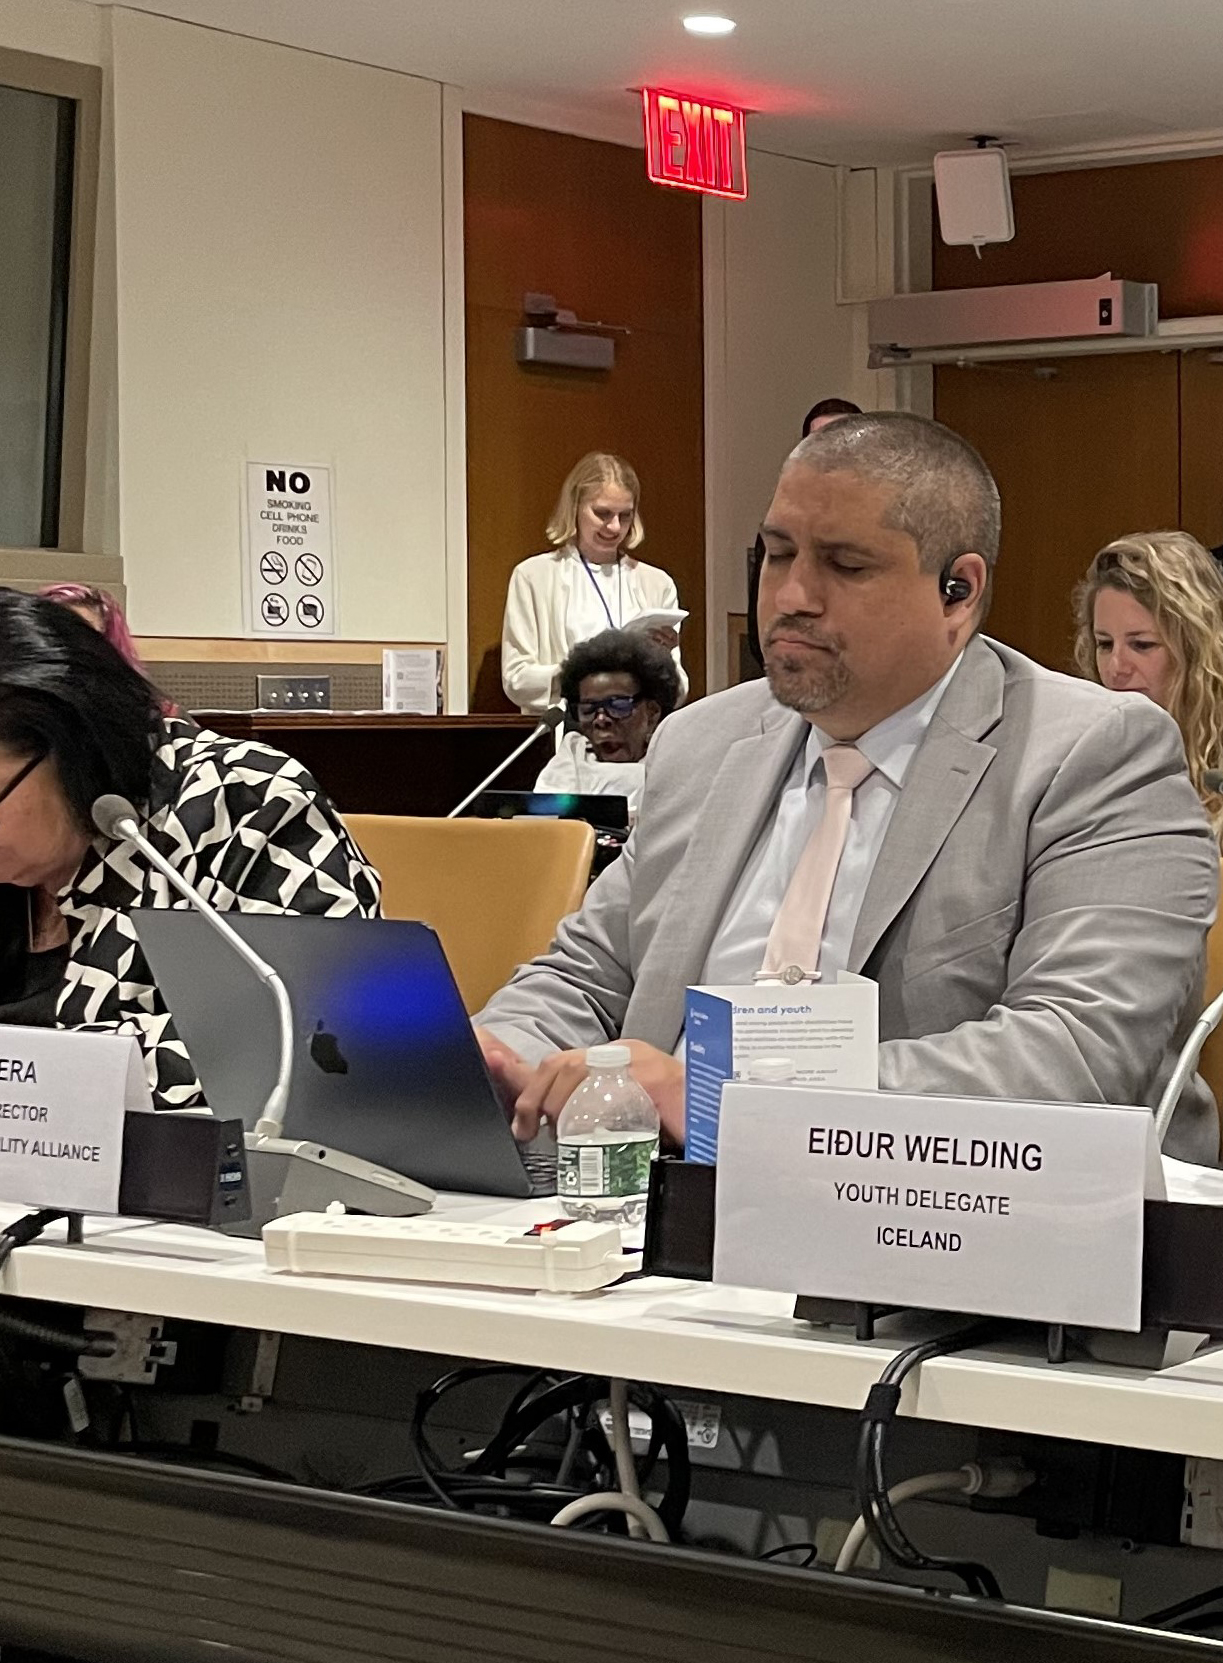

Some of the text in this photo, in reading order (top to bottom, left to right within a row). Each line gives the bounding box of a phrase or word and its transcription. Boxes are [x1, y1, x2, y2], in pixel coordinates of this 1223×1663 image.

[658, 95, 734, 188] EXIT
[266, 470, 311, 494] NO
[260, 511, 319, 523] CELL PHONE
[267, 499, 312, 511] SMOKING
[272, 523, 307, 534] DRINKS
[276, 535, 304, 545] FOOD
[758, 1006, 778, 1014] and
[781, 1006, 812, 1016] youth
[0, 1059, 37, 1083] ERA
[0, 1103, 48, 1123] ECTOR
[0, 1137, 101, 1162] LITY ALLIANCE
[808, 1127, 1043, 1172] EIÐUR WELDING
[834, 1182, 1011, 1216] YOUTH DELEGATE
[876, 1226, 963, 1252] ICELAND
